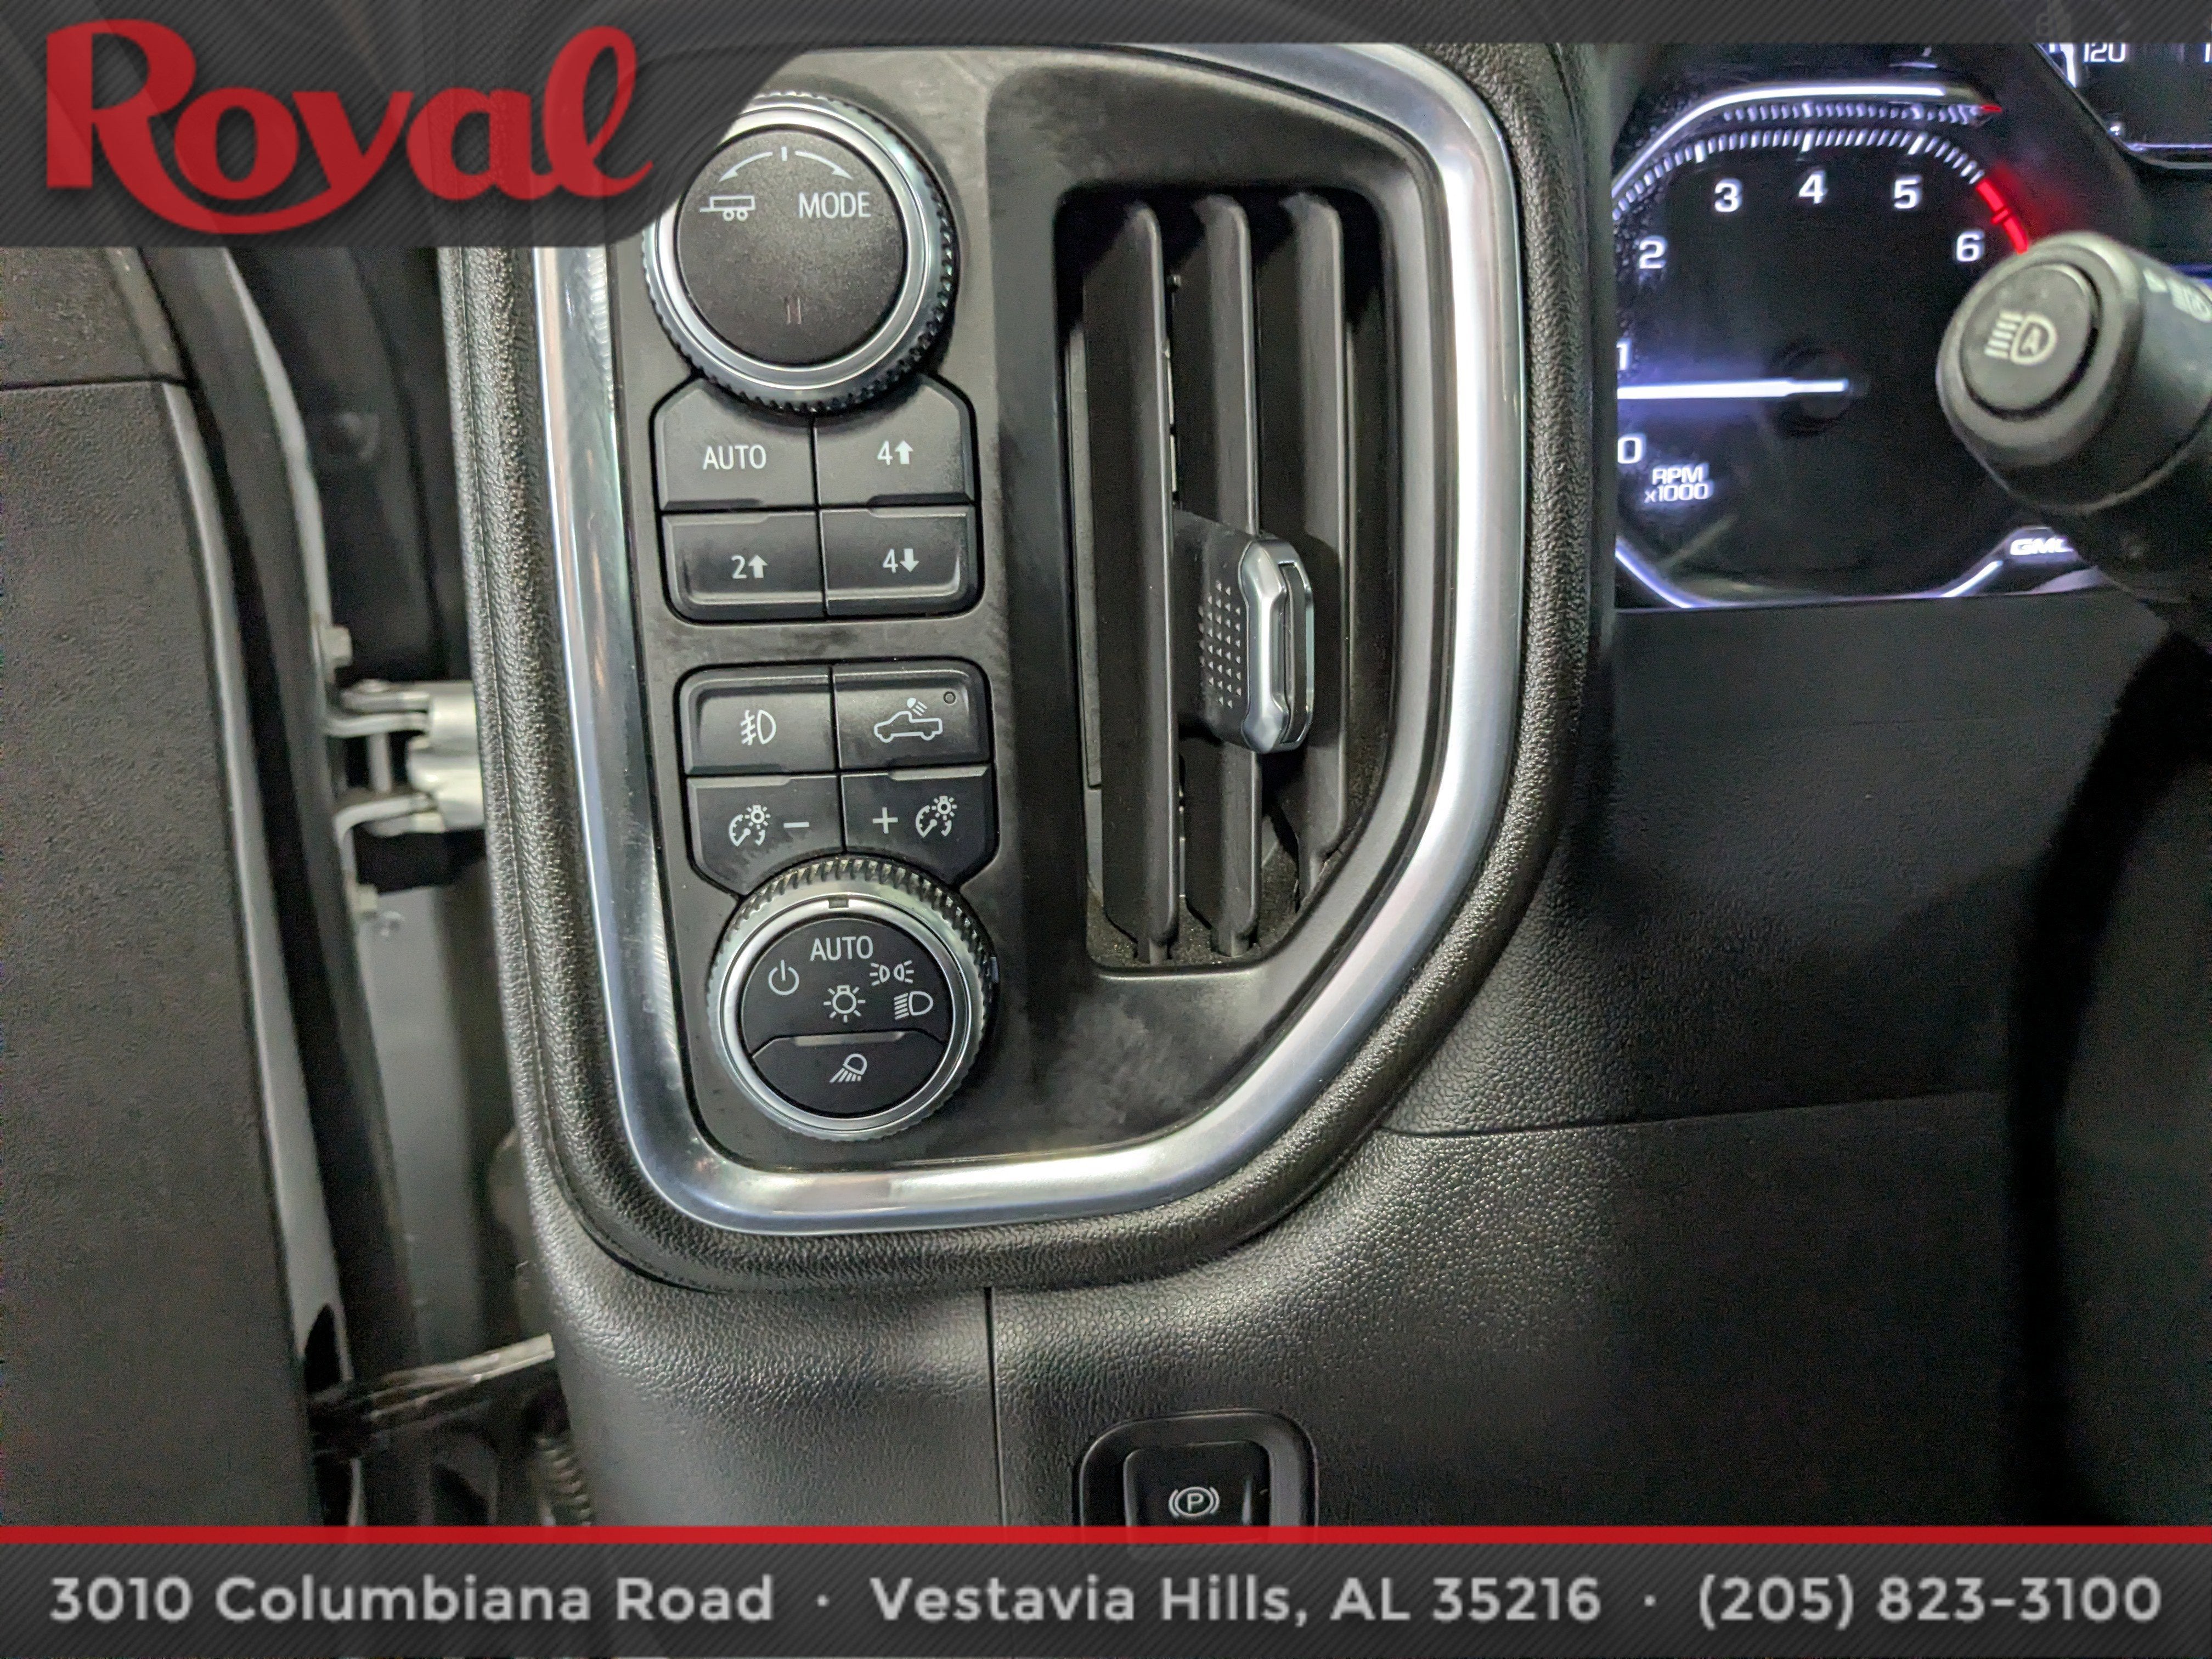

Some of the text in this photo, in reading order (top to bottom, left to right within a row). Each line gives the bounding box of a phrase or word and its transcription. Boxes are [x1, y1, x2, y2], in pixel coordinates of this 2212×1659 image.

[1714, 180, 1742, 213] 3
[1799, 172, 1826, 205] 4
[1894, 177, 1920, 210] 5
[798, 192, 871, 219] MODE
[1638, 237, 1666, 270] 2
[1956, 232, 1983, 262] 6
[703, 445, 767, 470] AUTO
[877, 441, 893, 465] 4
[1617, 433, 1646, 465] 0
[1651, 464, 1708, 485] RPM
[1644, 483, 1710, 503] x1000
[731, 555, 747, 579] 2
[882, 549, 899, 573] 4
[810, 935, 874, 961] AUTO
